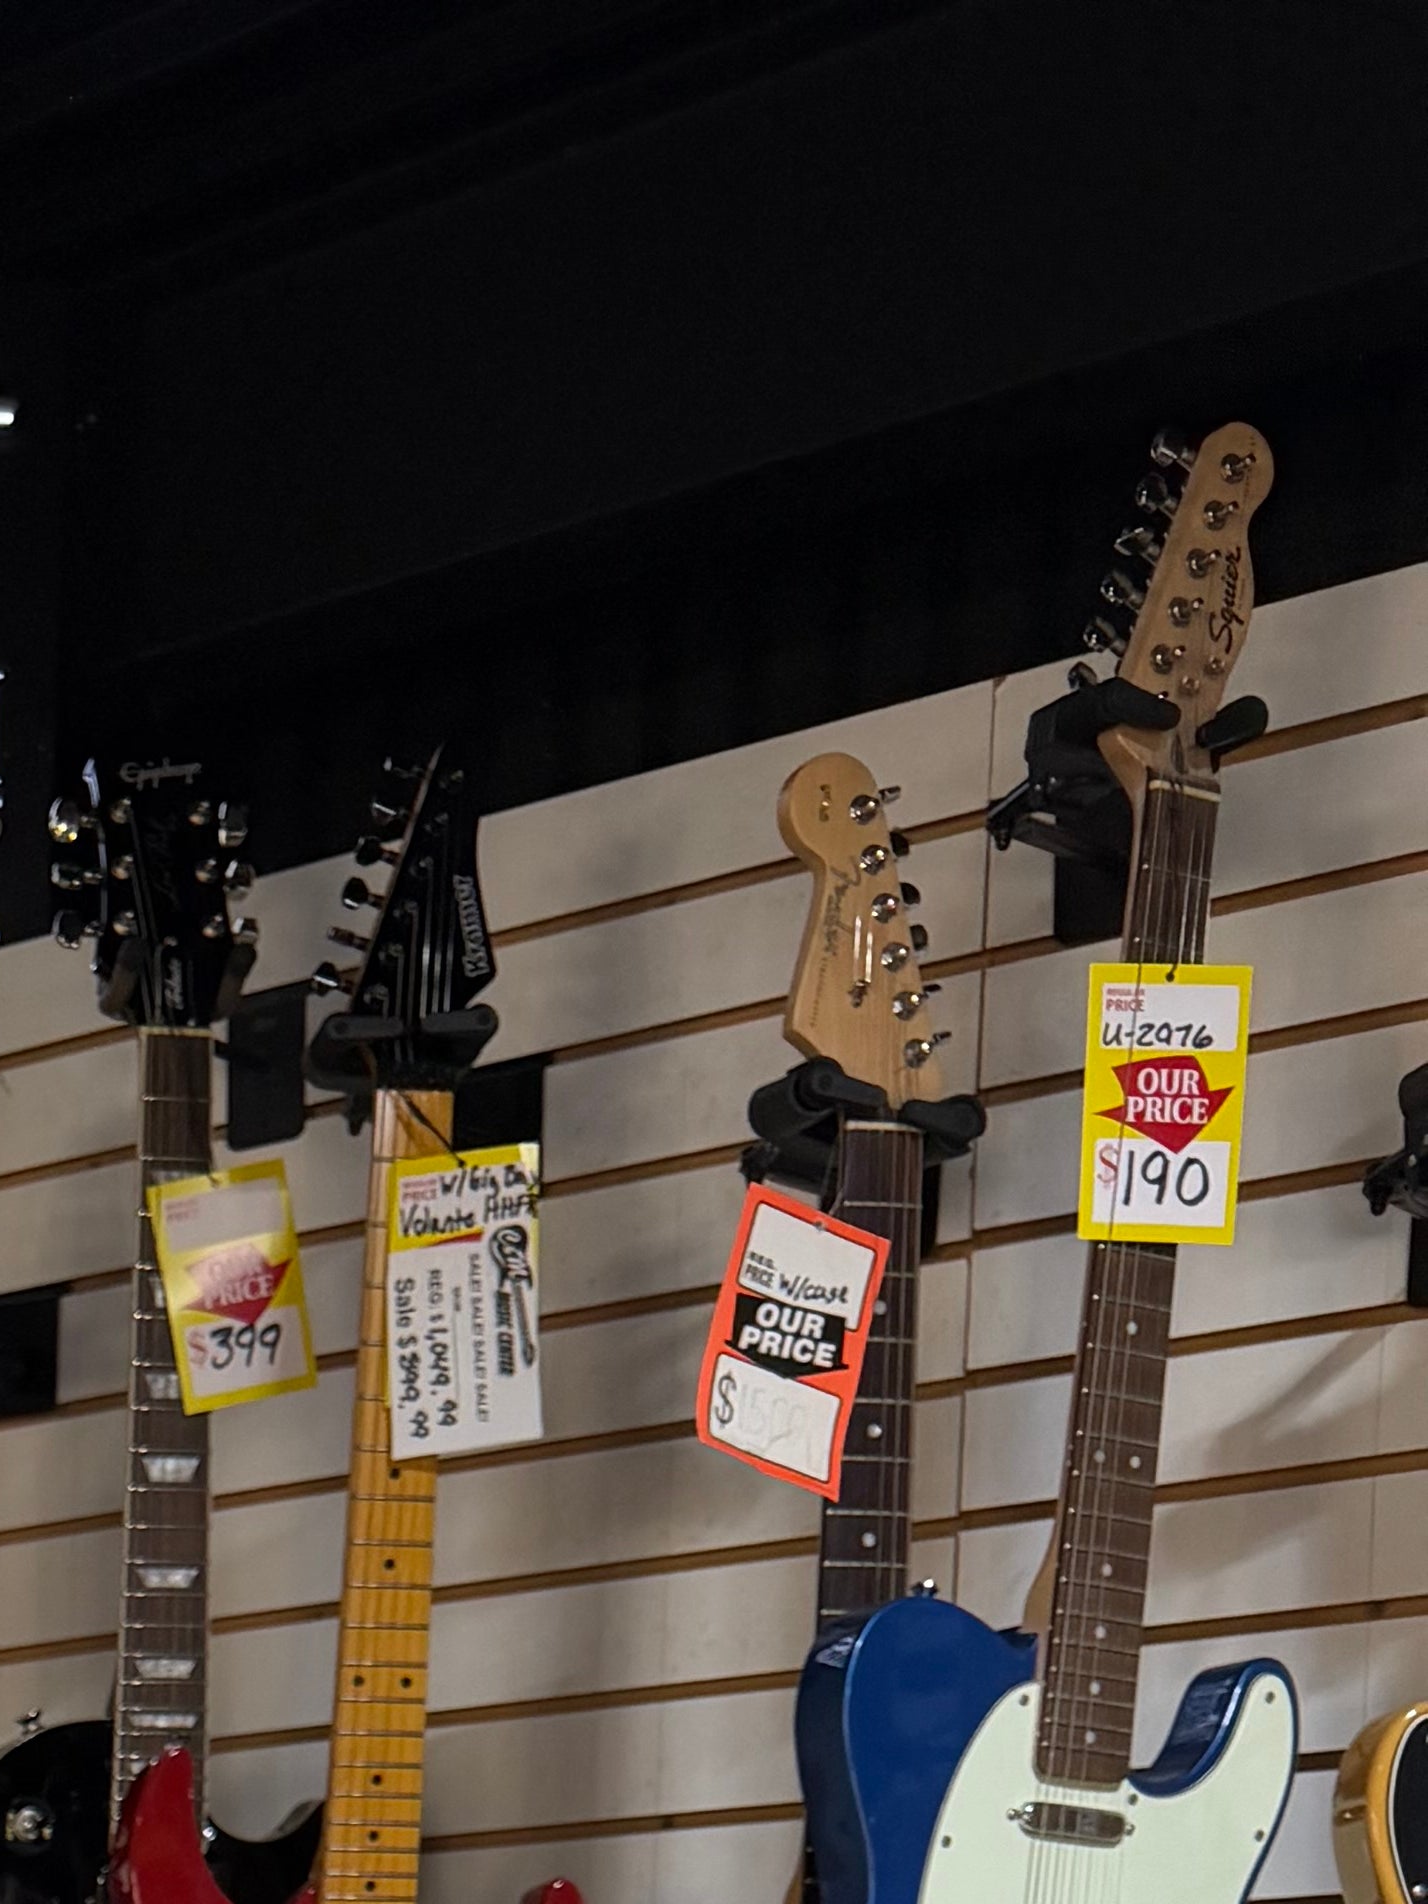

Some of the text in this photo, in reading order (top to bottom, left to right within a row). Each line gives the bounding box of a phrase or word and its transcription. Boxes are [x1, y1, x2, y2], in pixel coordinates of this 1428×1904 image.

[1208, 546, 1245, 655] Squier
[1105, 999, 1145, 1013] PRICE
[1137, 1067, 1200, 1096] OUR
[1124, 1095, 1210, 1125] PRICE
[203, 1274, 276, 1310] PRICE
[744, 1265, 775, 1289] PRICE
[755, 1302, 826, 1340] OUR
[187, 1322, 282, 1372] $399
[496, 1331, 517, 1378] CENTER
[738, 1324, 838, 1369] PRICE
